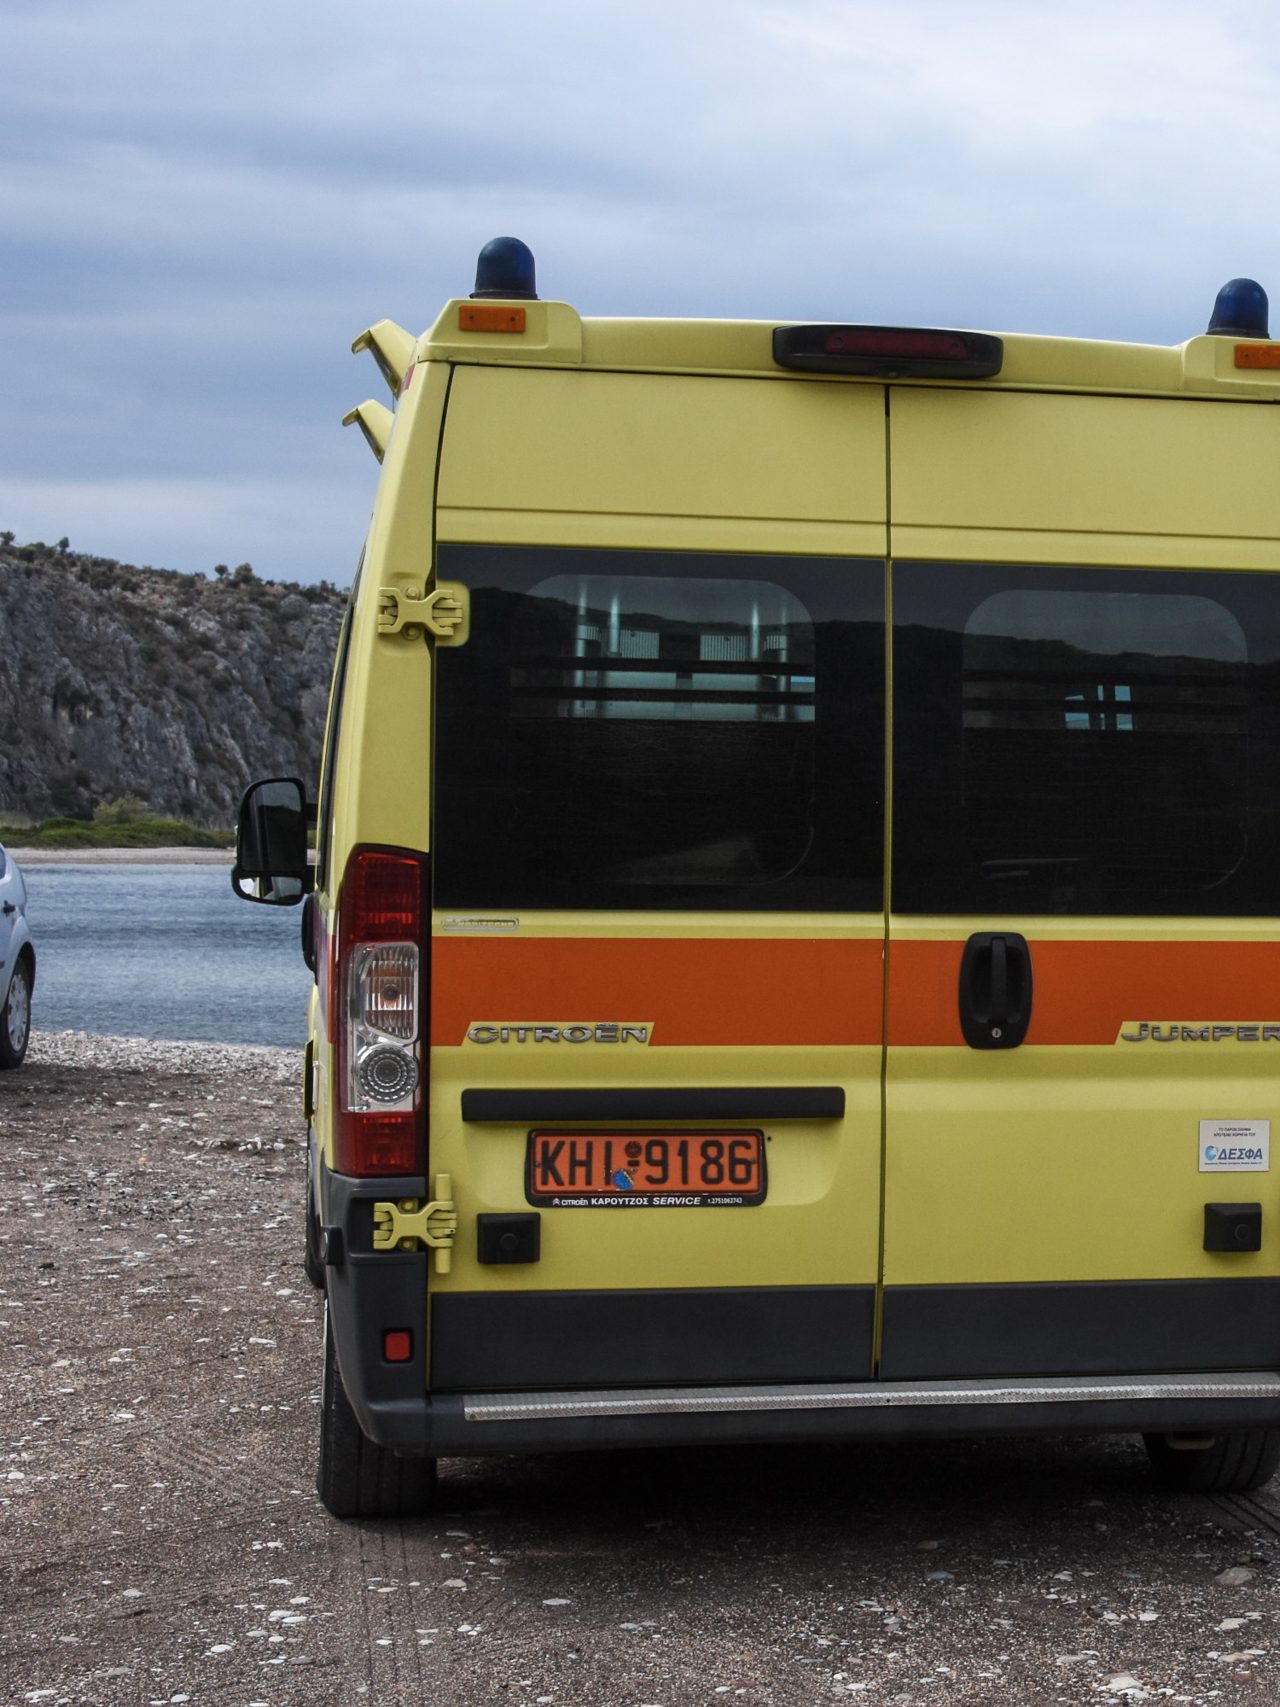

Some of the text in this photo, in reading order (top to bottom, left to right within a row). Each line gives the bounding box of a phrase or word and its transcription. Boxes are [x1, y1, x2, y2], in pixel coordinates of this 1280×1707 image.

[467, 1023, 649, 1044] CITROËN
[1217, 1148, 1263, 1160] ΔΕΣΦΑ
[591, 1198, 649, 1206] ΚΑΡΟΥΤΖΟΣ
[652, 1196, 701, 1206] SERVICE
